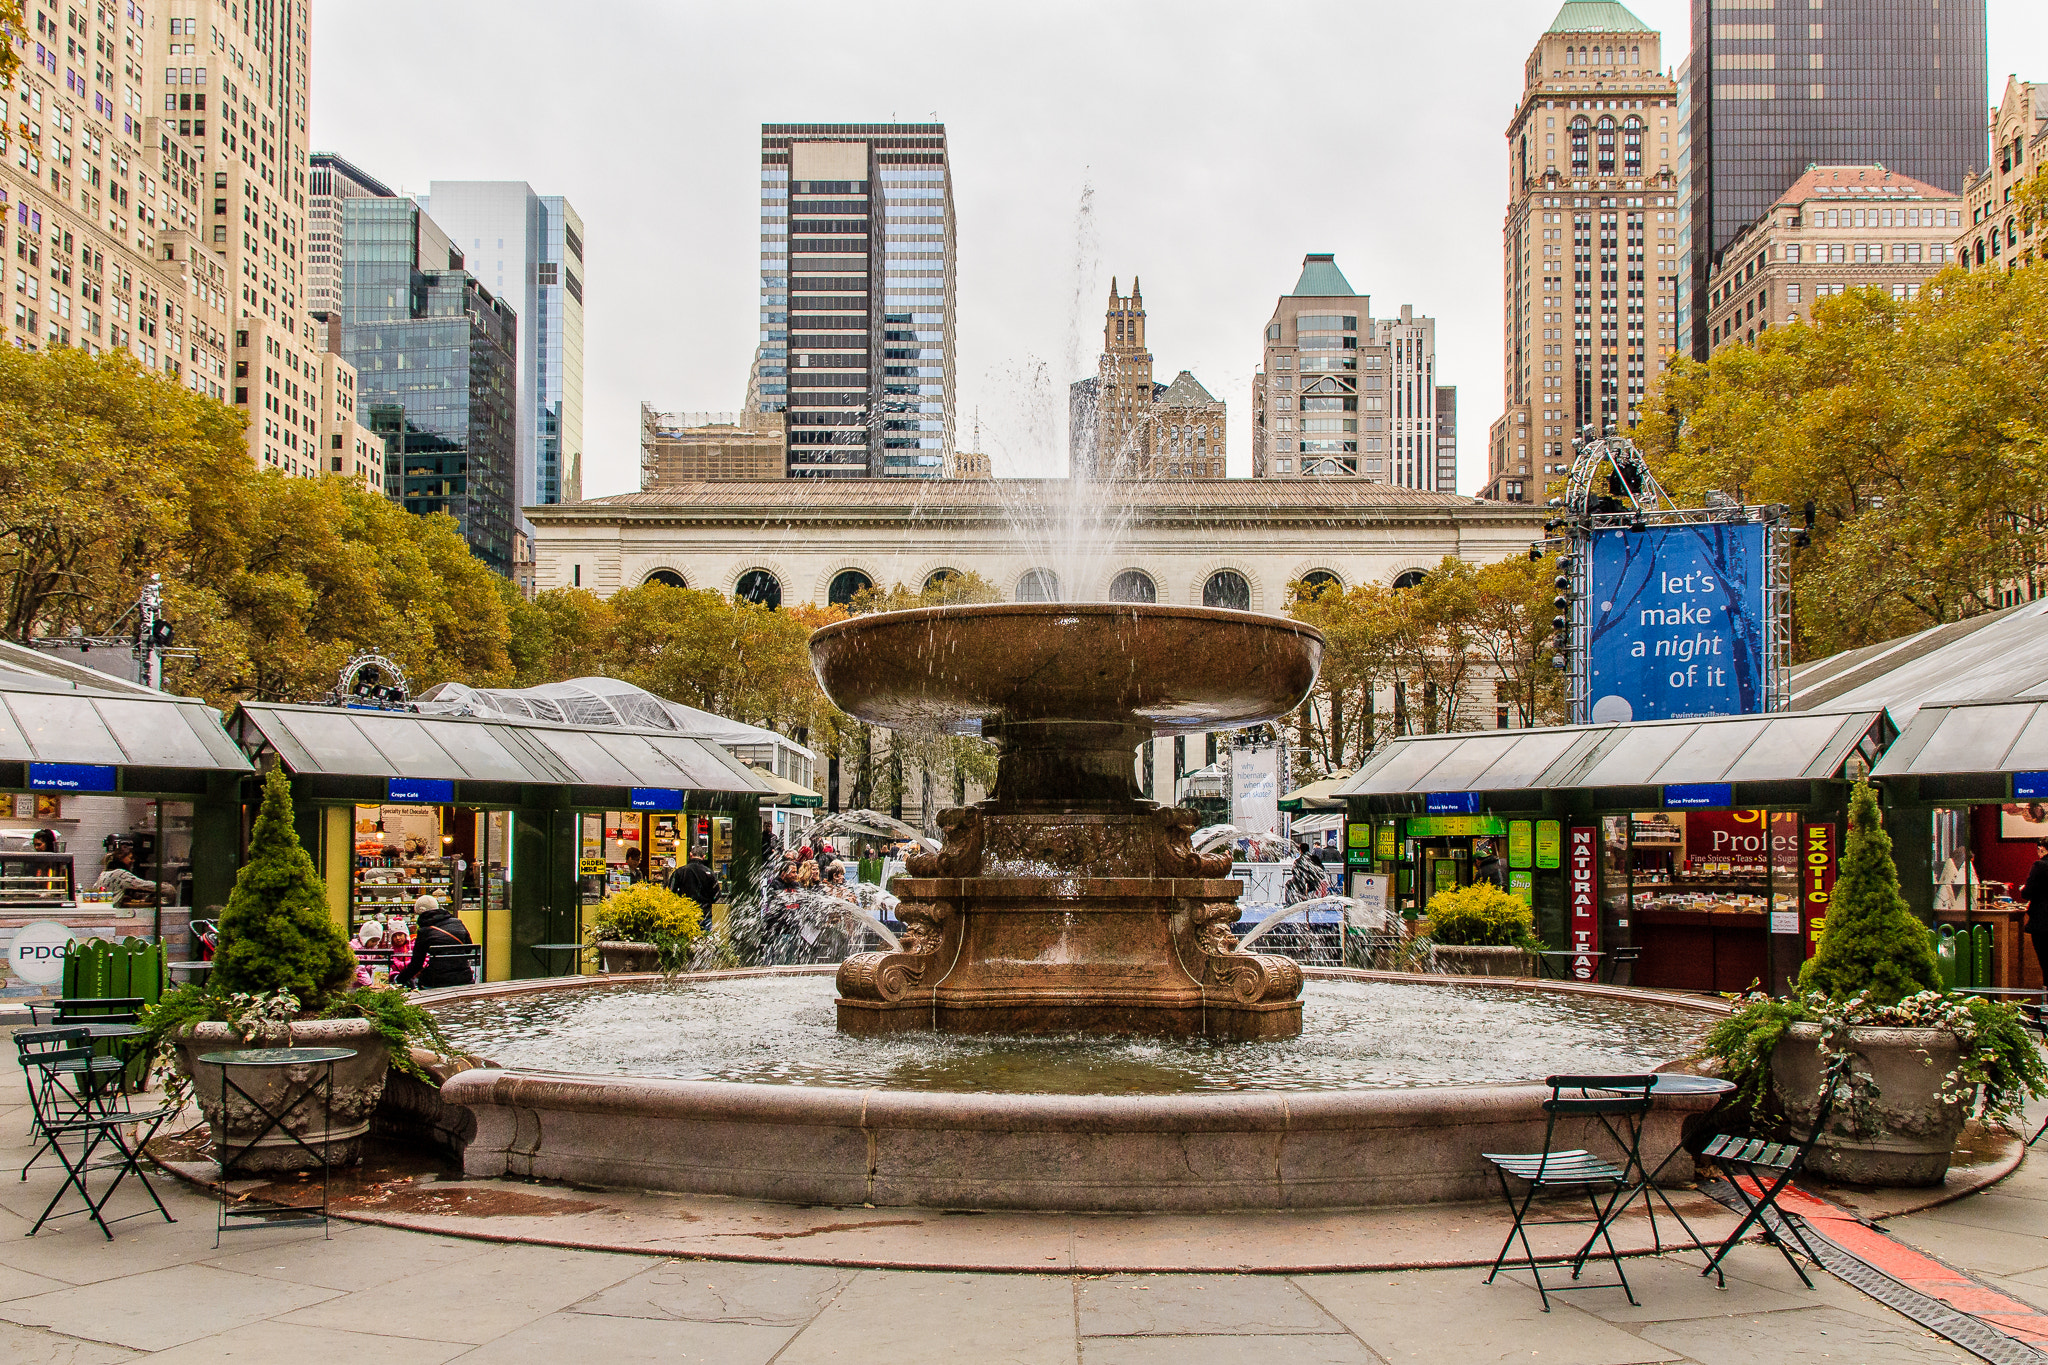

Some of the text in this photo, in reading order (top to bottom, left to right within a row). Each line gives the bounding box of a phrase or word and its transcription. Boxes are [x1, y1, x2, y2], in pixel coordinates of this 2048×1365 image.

[1662, 570, 1715, 594] let's
[1641, 602, 1711, 626] make
[1631, 632, 1722, 662] a night
[1669, 664, 1726, 688] of it
[1242, 762, 1254, 771] why
[1238, 772, 1267, 780] hibernate
[1262, 782, 1274, 790] you
[1252, 790, 1272, 798] skate?
[1378, 845, 1404, 855] PICKS
[1691, 854, 1706, 862] Fine
[1707, 854, 1731, 863] Spices
[1736, 854, 1752, 862] Teas
[1808, 827, 1829, 903] EXOTIC
[1510, 880, 1531, 889] Ship
[1359, 893, 1378, 901] Skating
[1574, 832, 1592, 979] NATURAL TEAS
[20, 946, 66, 960] PDQ
